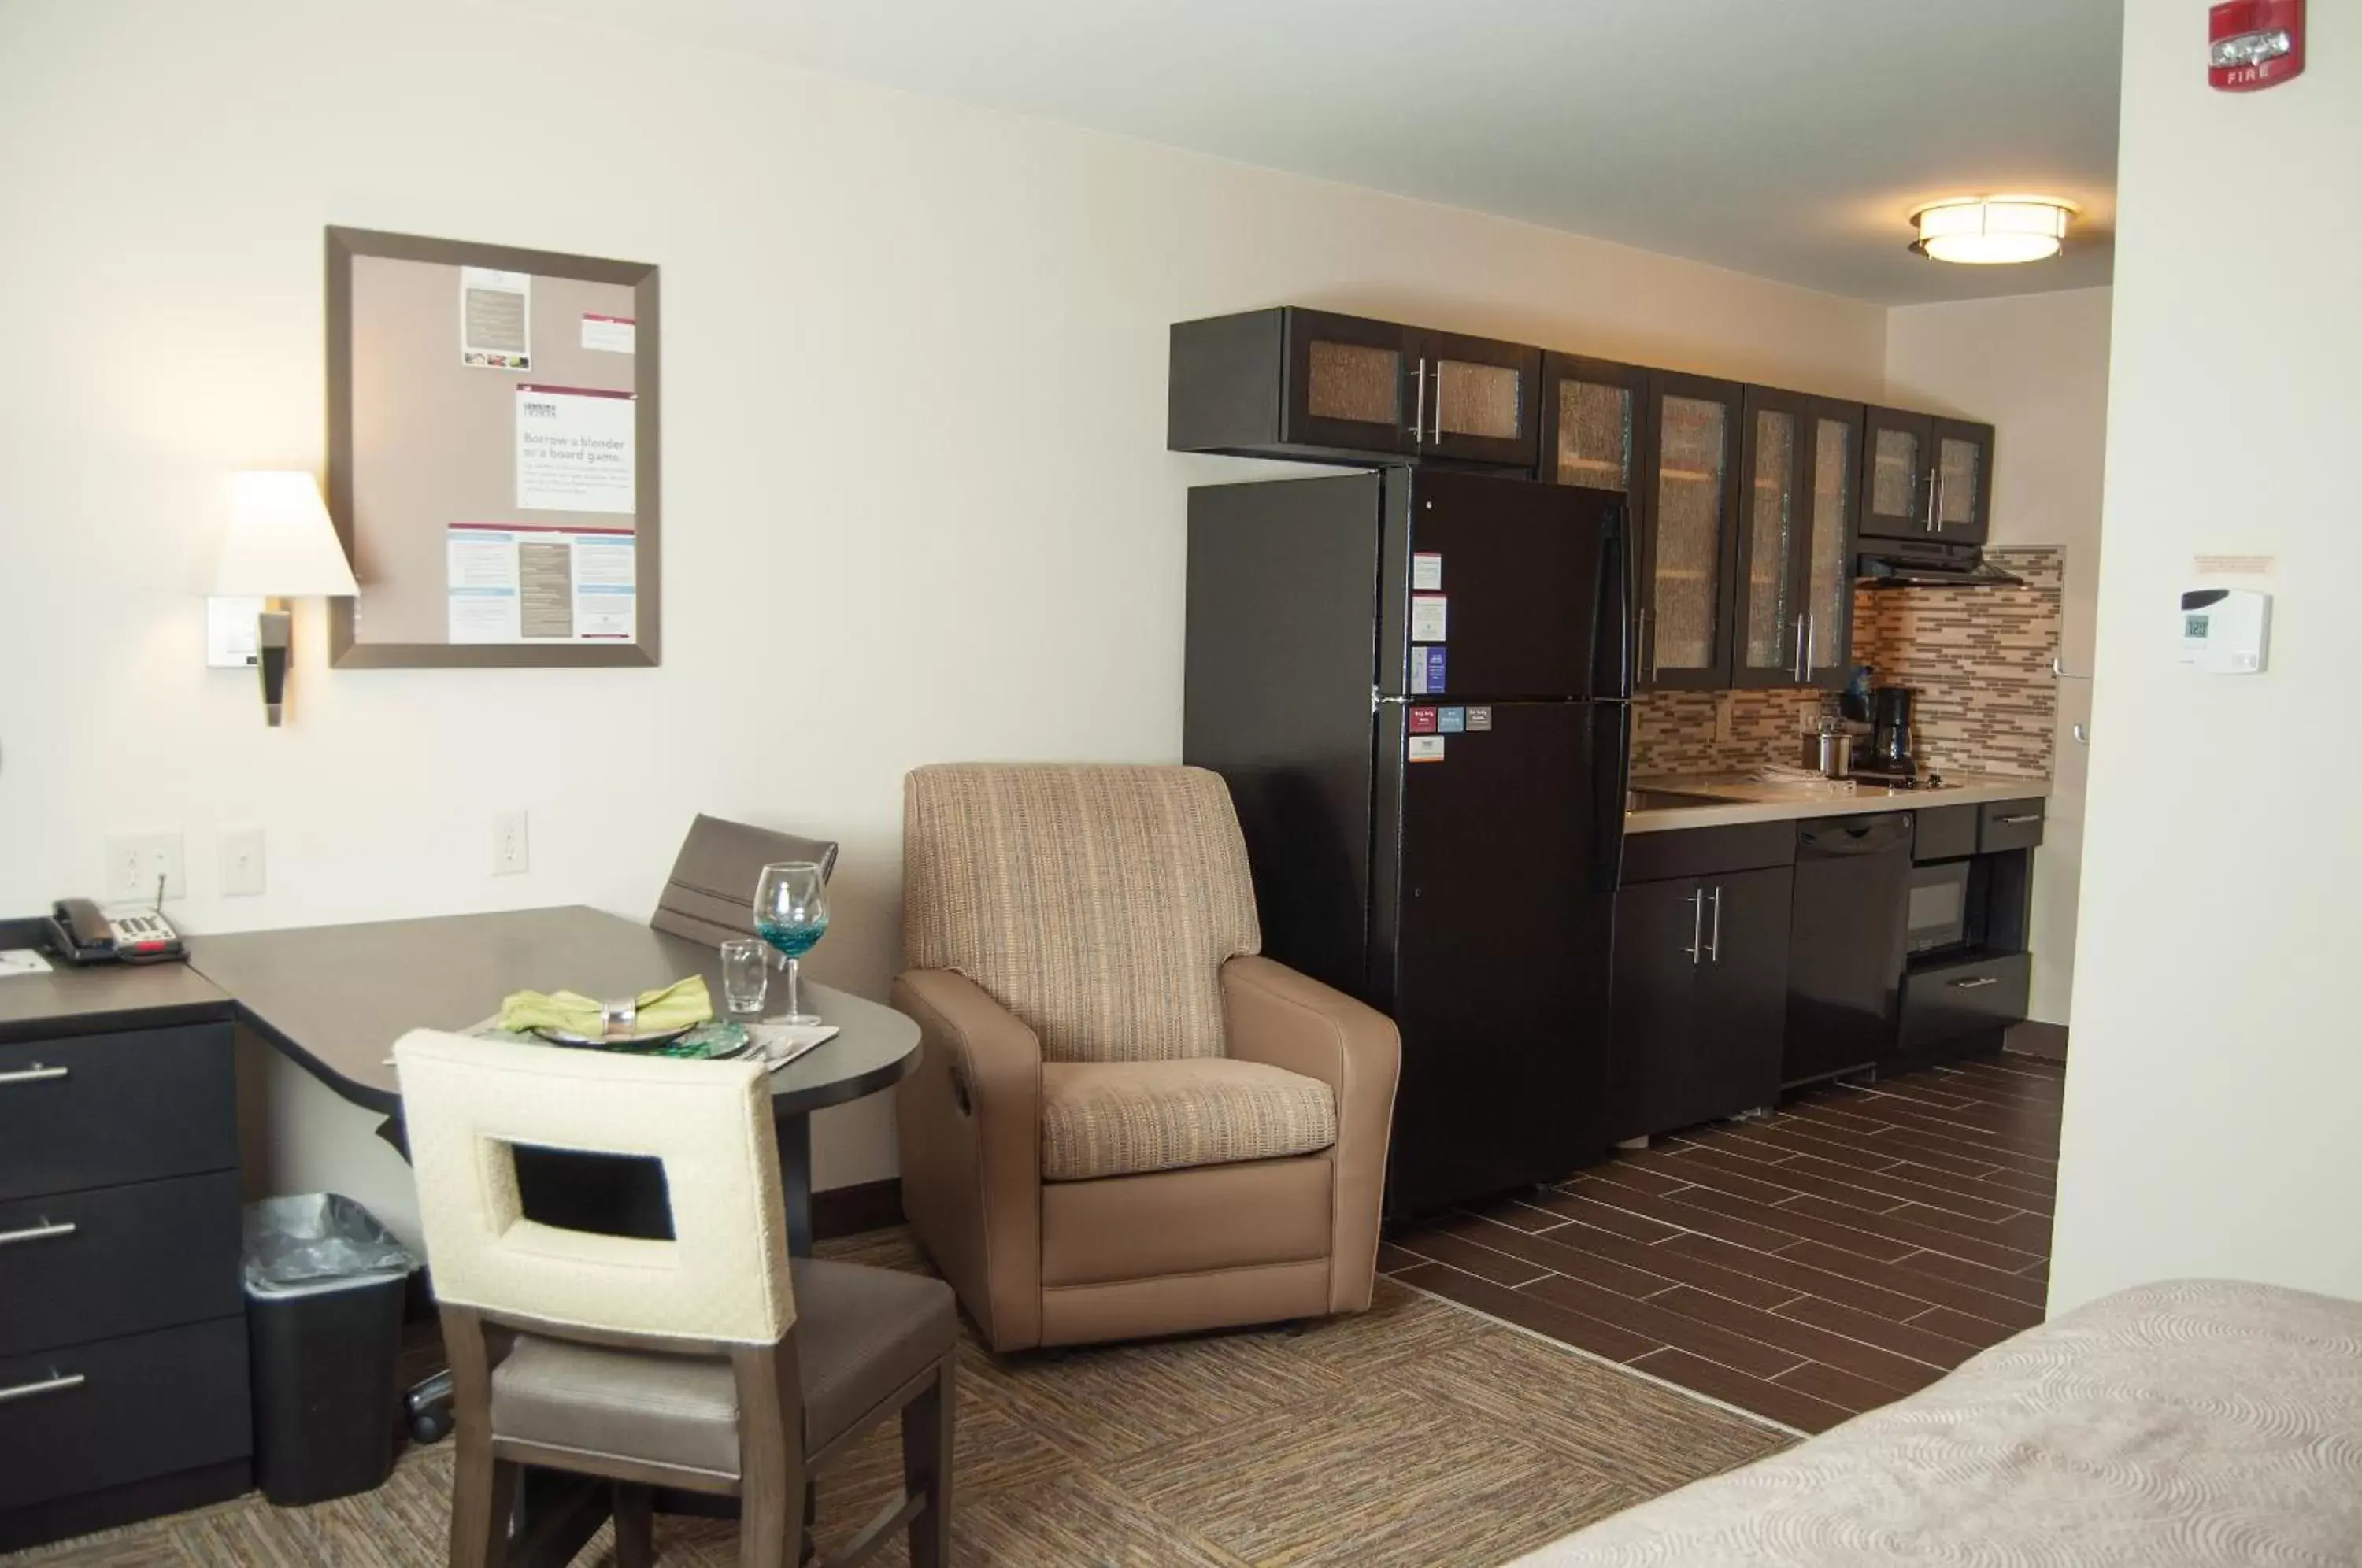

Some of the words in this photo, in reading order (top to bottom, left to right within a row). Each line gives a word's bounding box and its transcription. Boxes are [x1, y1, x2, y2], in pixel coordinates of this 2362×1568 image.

[2227, 66, 2268, 84] FIRE
[524, 432, 568, 446] Borrow
[581, 436, 624, 450] blender
[550, 447, 583, 460] board
